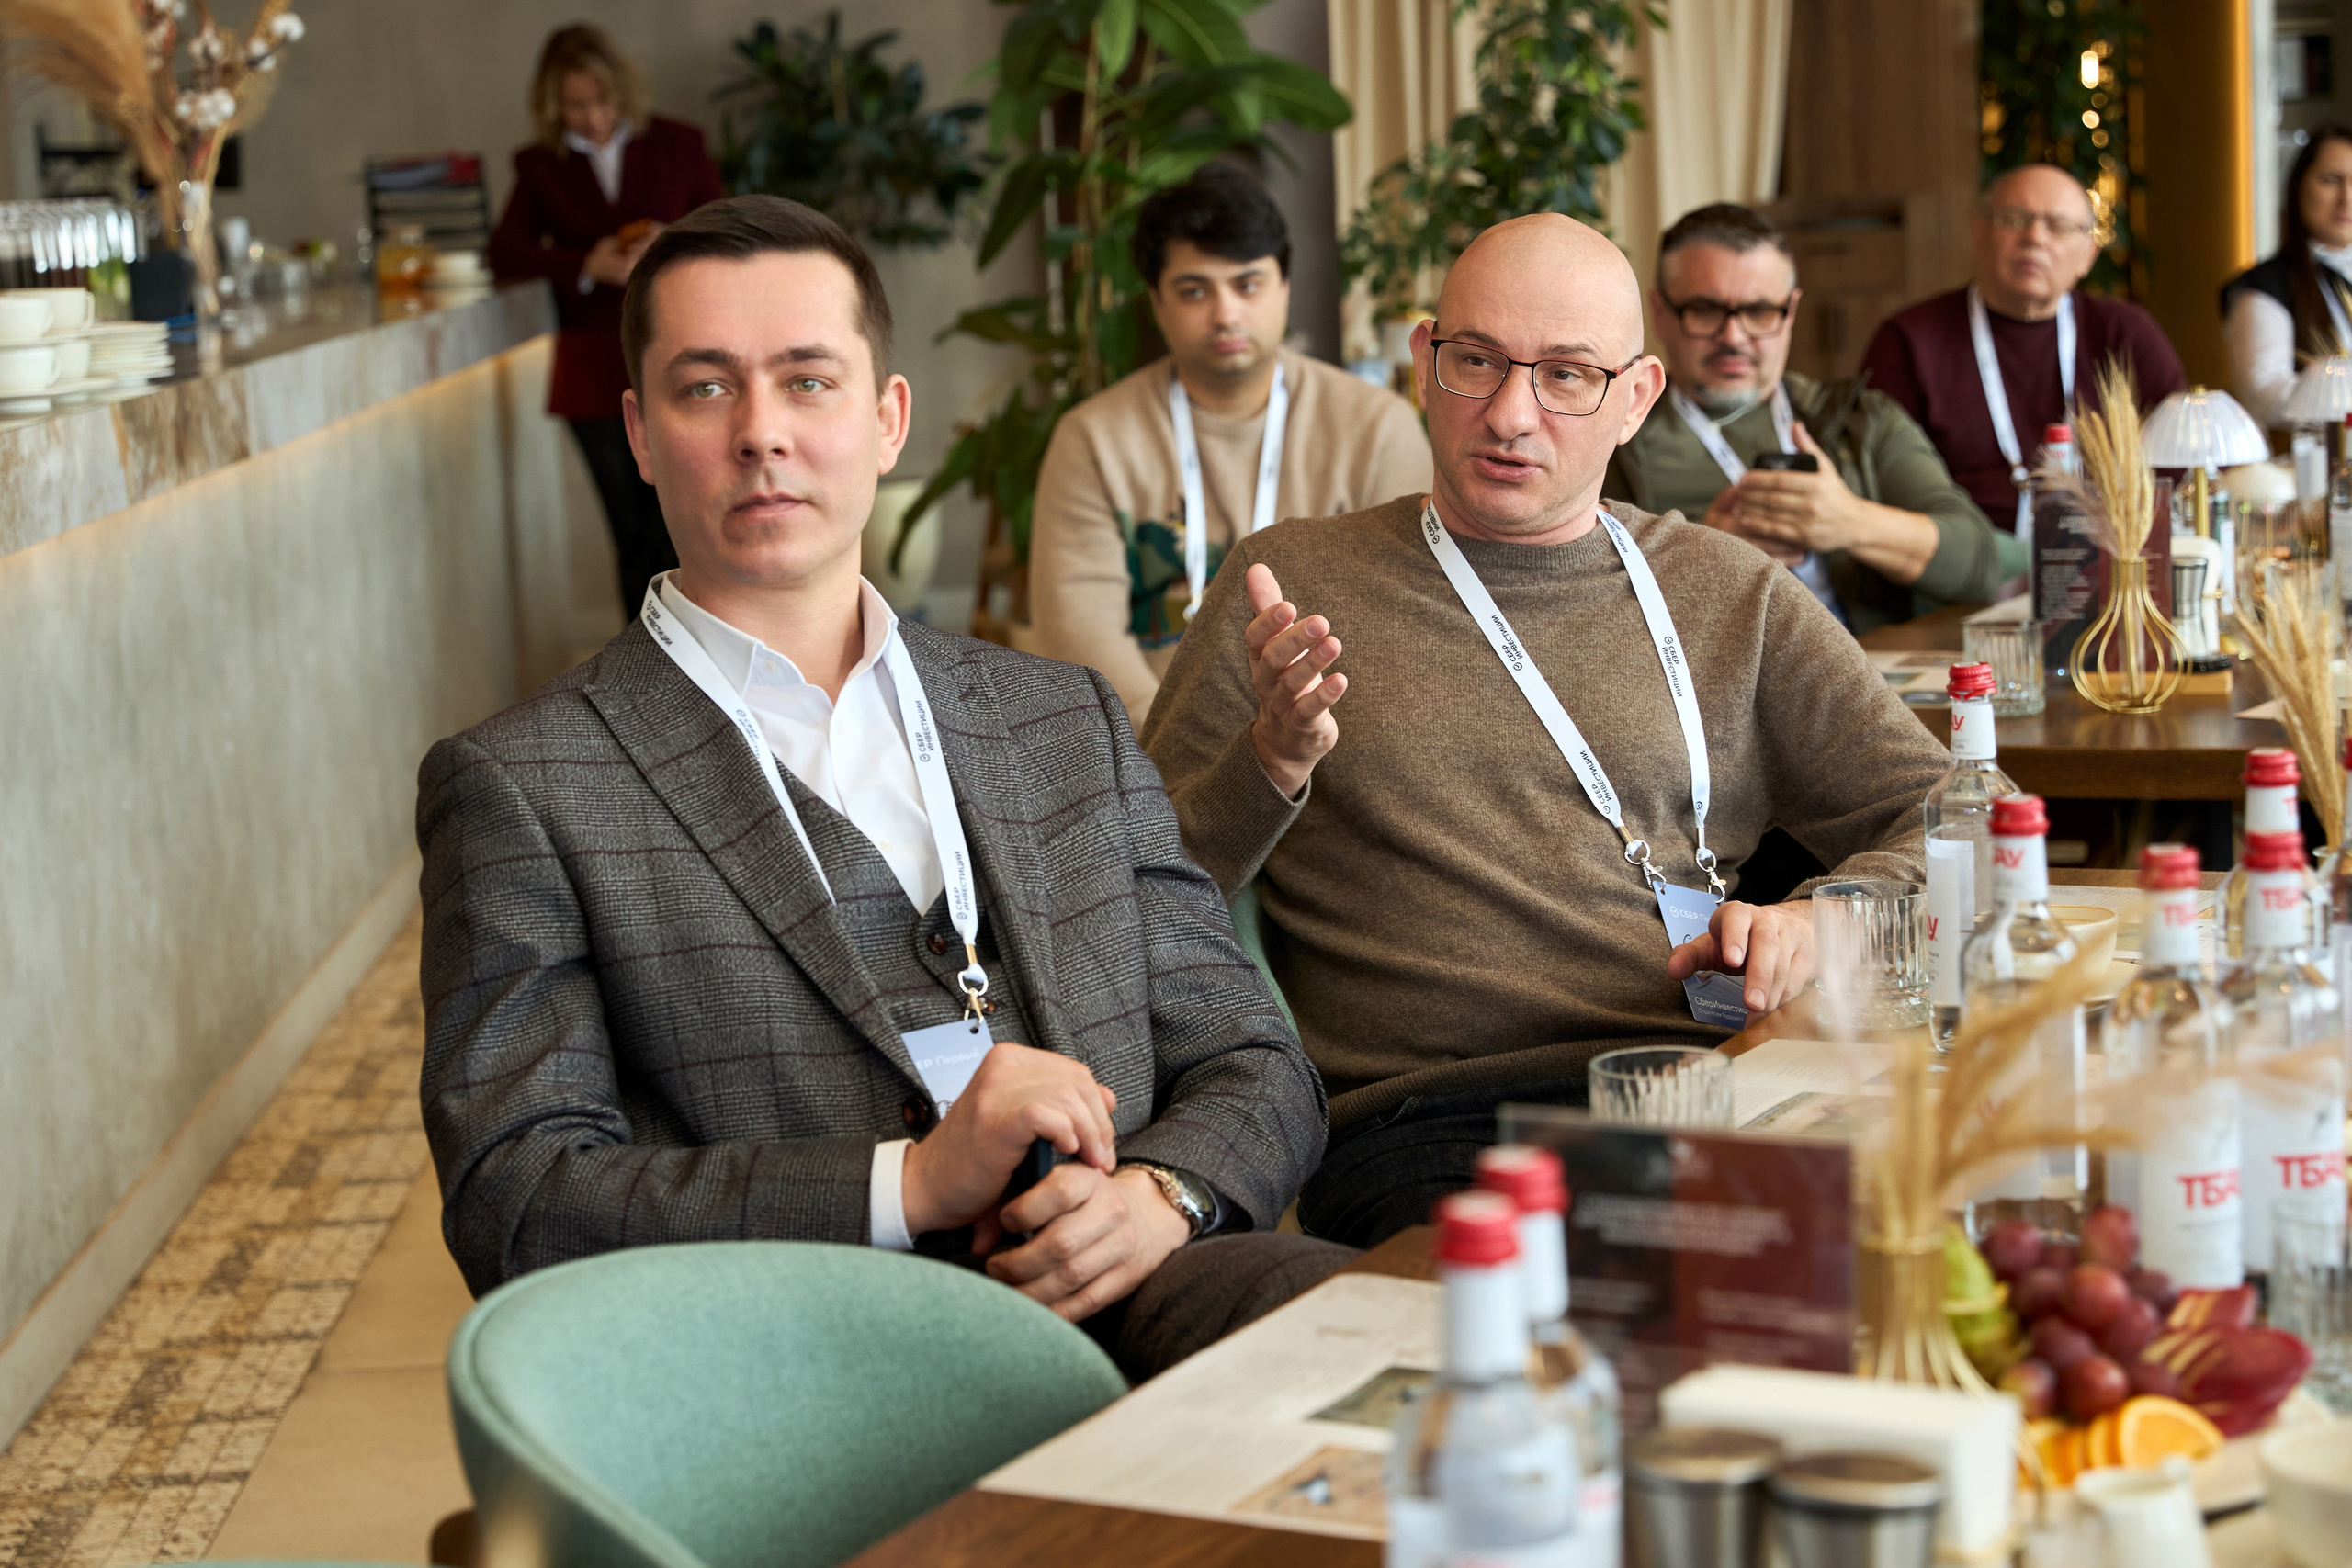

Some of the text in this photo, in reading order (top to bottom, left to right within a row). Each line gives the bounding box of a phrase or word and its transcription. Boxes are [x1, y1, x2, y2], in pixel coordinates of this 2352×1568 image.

[1491, 614, 1524, 660] ИНВЕСТИЦИИ
[1501, 644, 1517, 662] СБЕР
[1668, 645, 1679, 665] СБЕР
[1662, 646, 1682, 698] ИНВЕСТИЦИИ
[915, 700, 934, 751] ИНВЕСТИЦИИ
[914, 732, 926, 752] СБЕР
[1579, 750, 1612, 802] ИНВЕСТИЦИИ
[1591, 784, 1606, 805] СБЕР
[955, 851, 970, 911] ИНВЕСТИЦИИ
[954, 886, 963, 911] СБЕР
[1679, 908, 1699, 920] СБЕР
[1694, 996, 1748, 1016] СберИнвестиц
[1698, 1007, 1722, 1018] Стратегии
[934, 1047, 980, 1066] Первый
